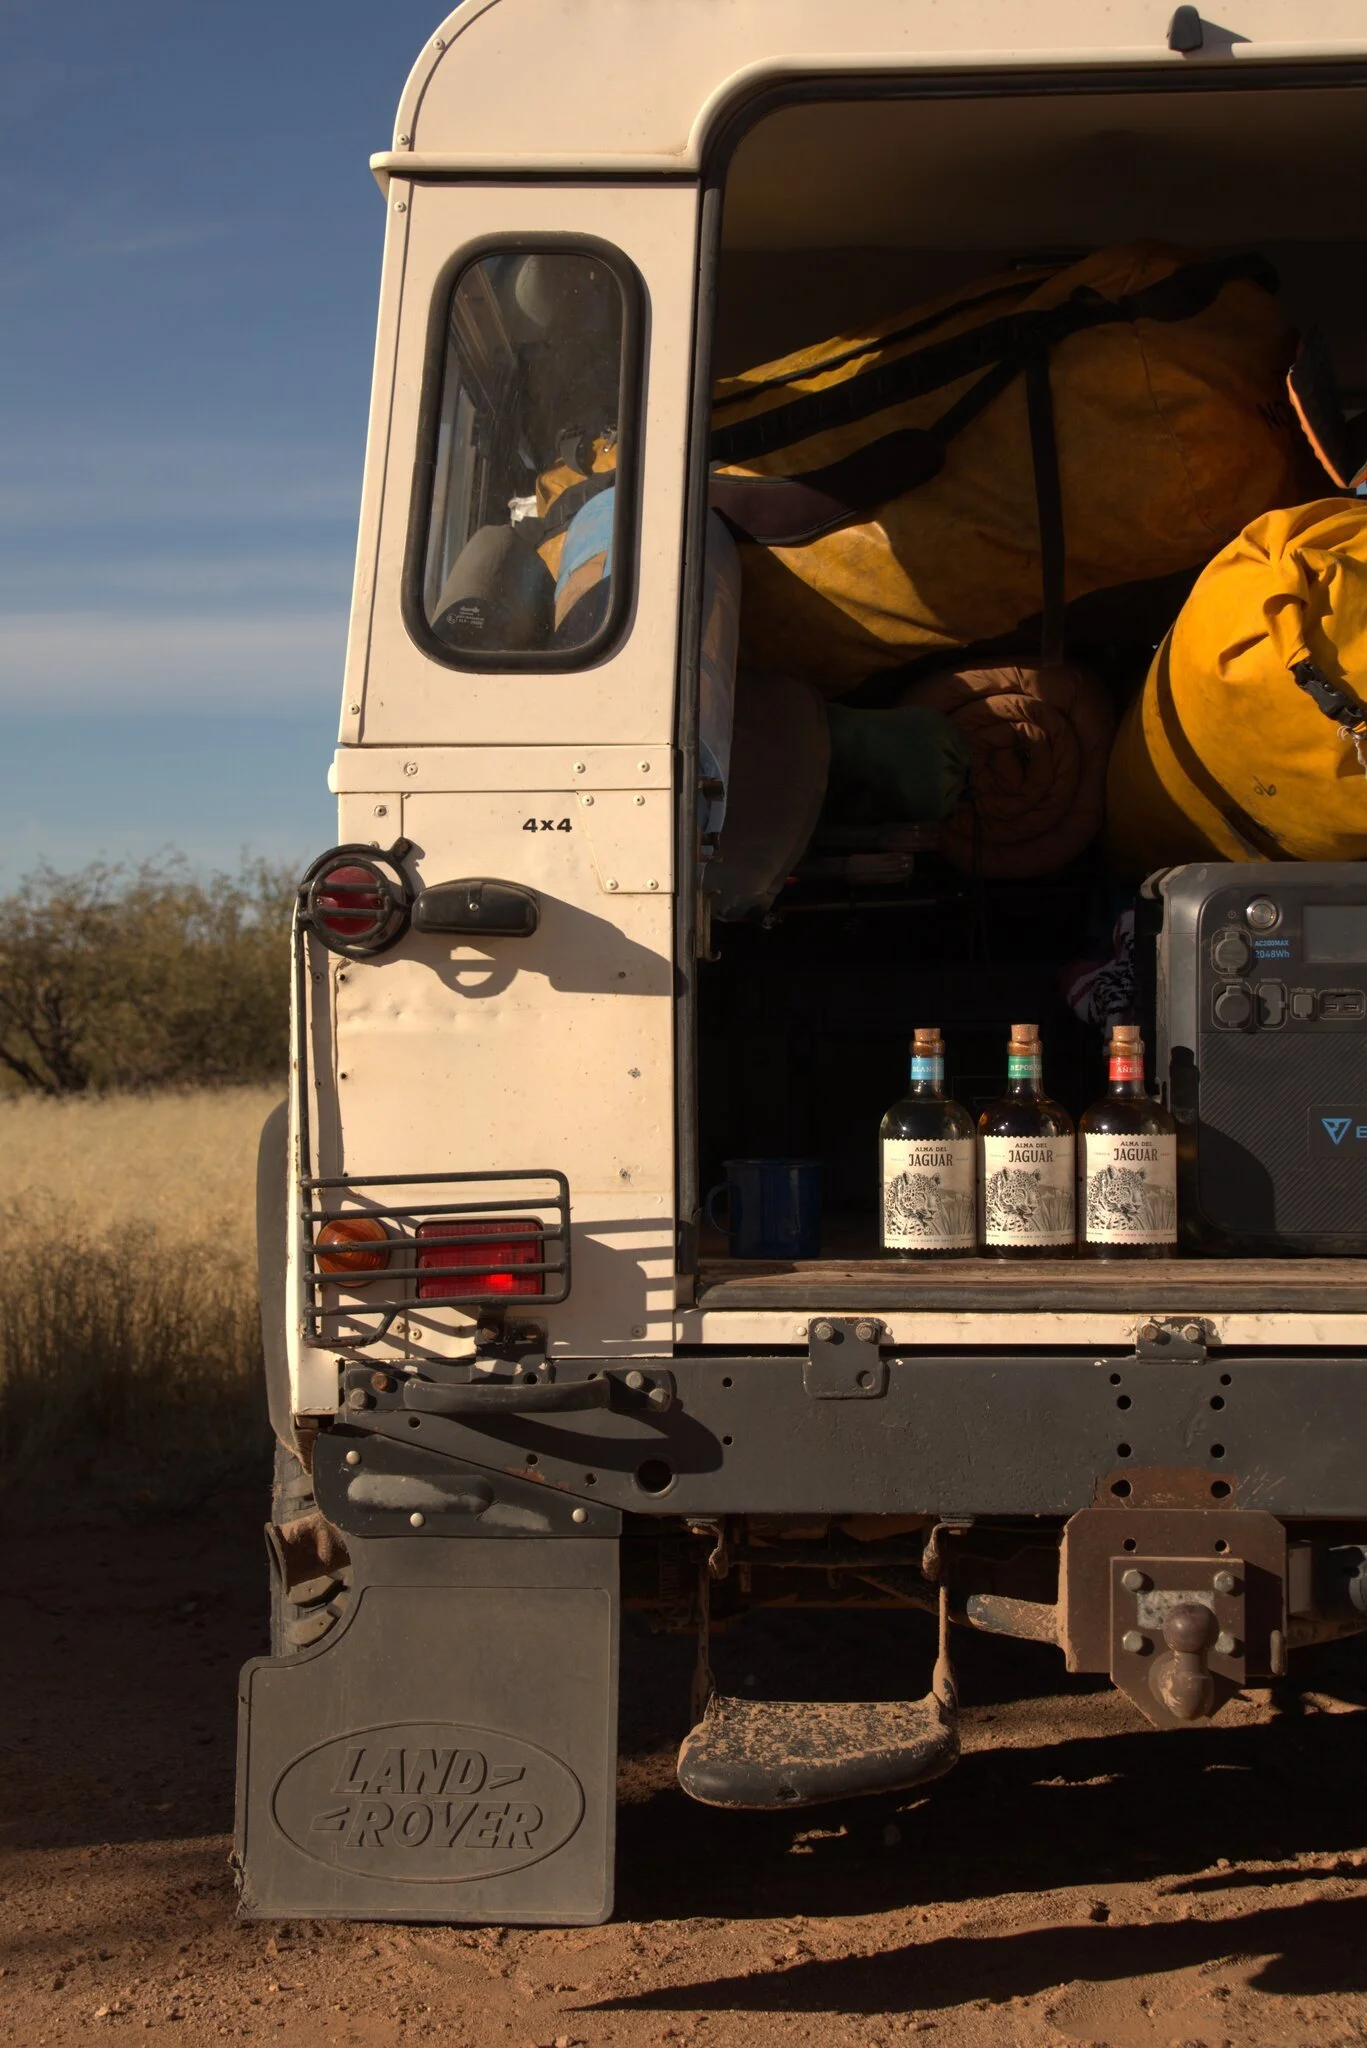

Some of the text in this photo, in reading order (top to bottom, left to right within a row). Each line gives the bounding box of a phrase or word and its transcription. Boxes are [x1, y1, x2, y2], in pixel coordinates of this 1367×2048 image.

[522, 817, 573, 833] 4x4
[1255, 949, 1290, 959] 2048Wh
[908, 1153, 954, 1167] JAGUAR
[1008, 1150, 1054, 1163] JAGUAR
[1113, 1148, 1159, 1162] JAGUAR
[332, 1746, 488, 1796] LAND
[344, 1799, 544, 1850] ROVER
